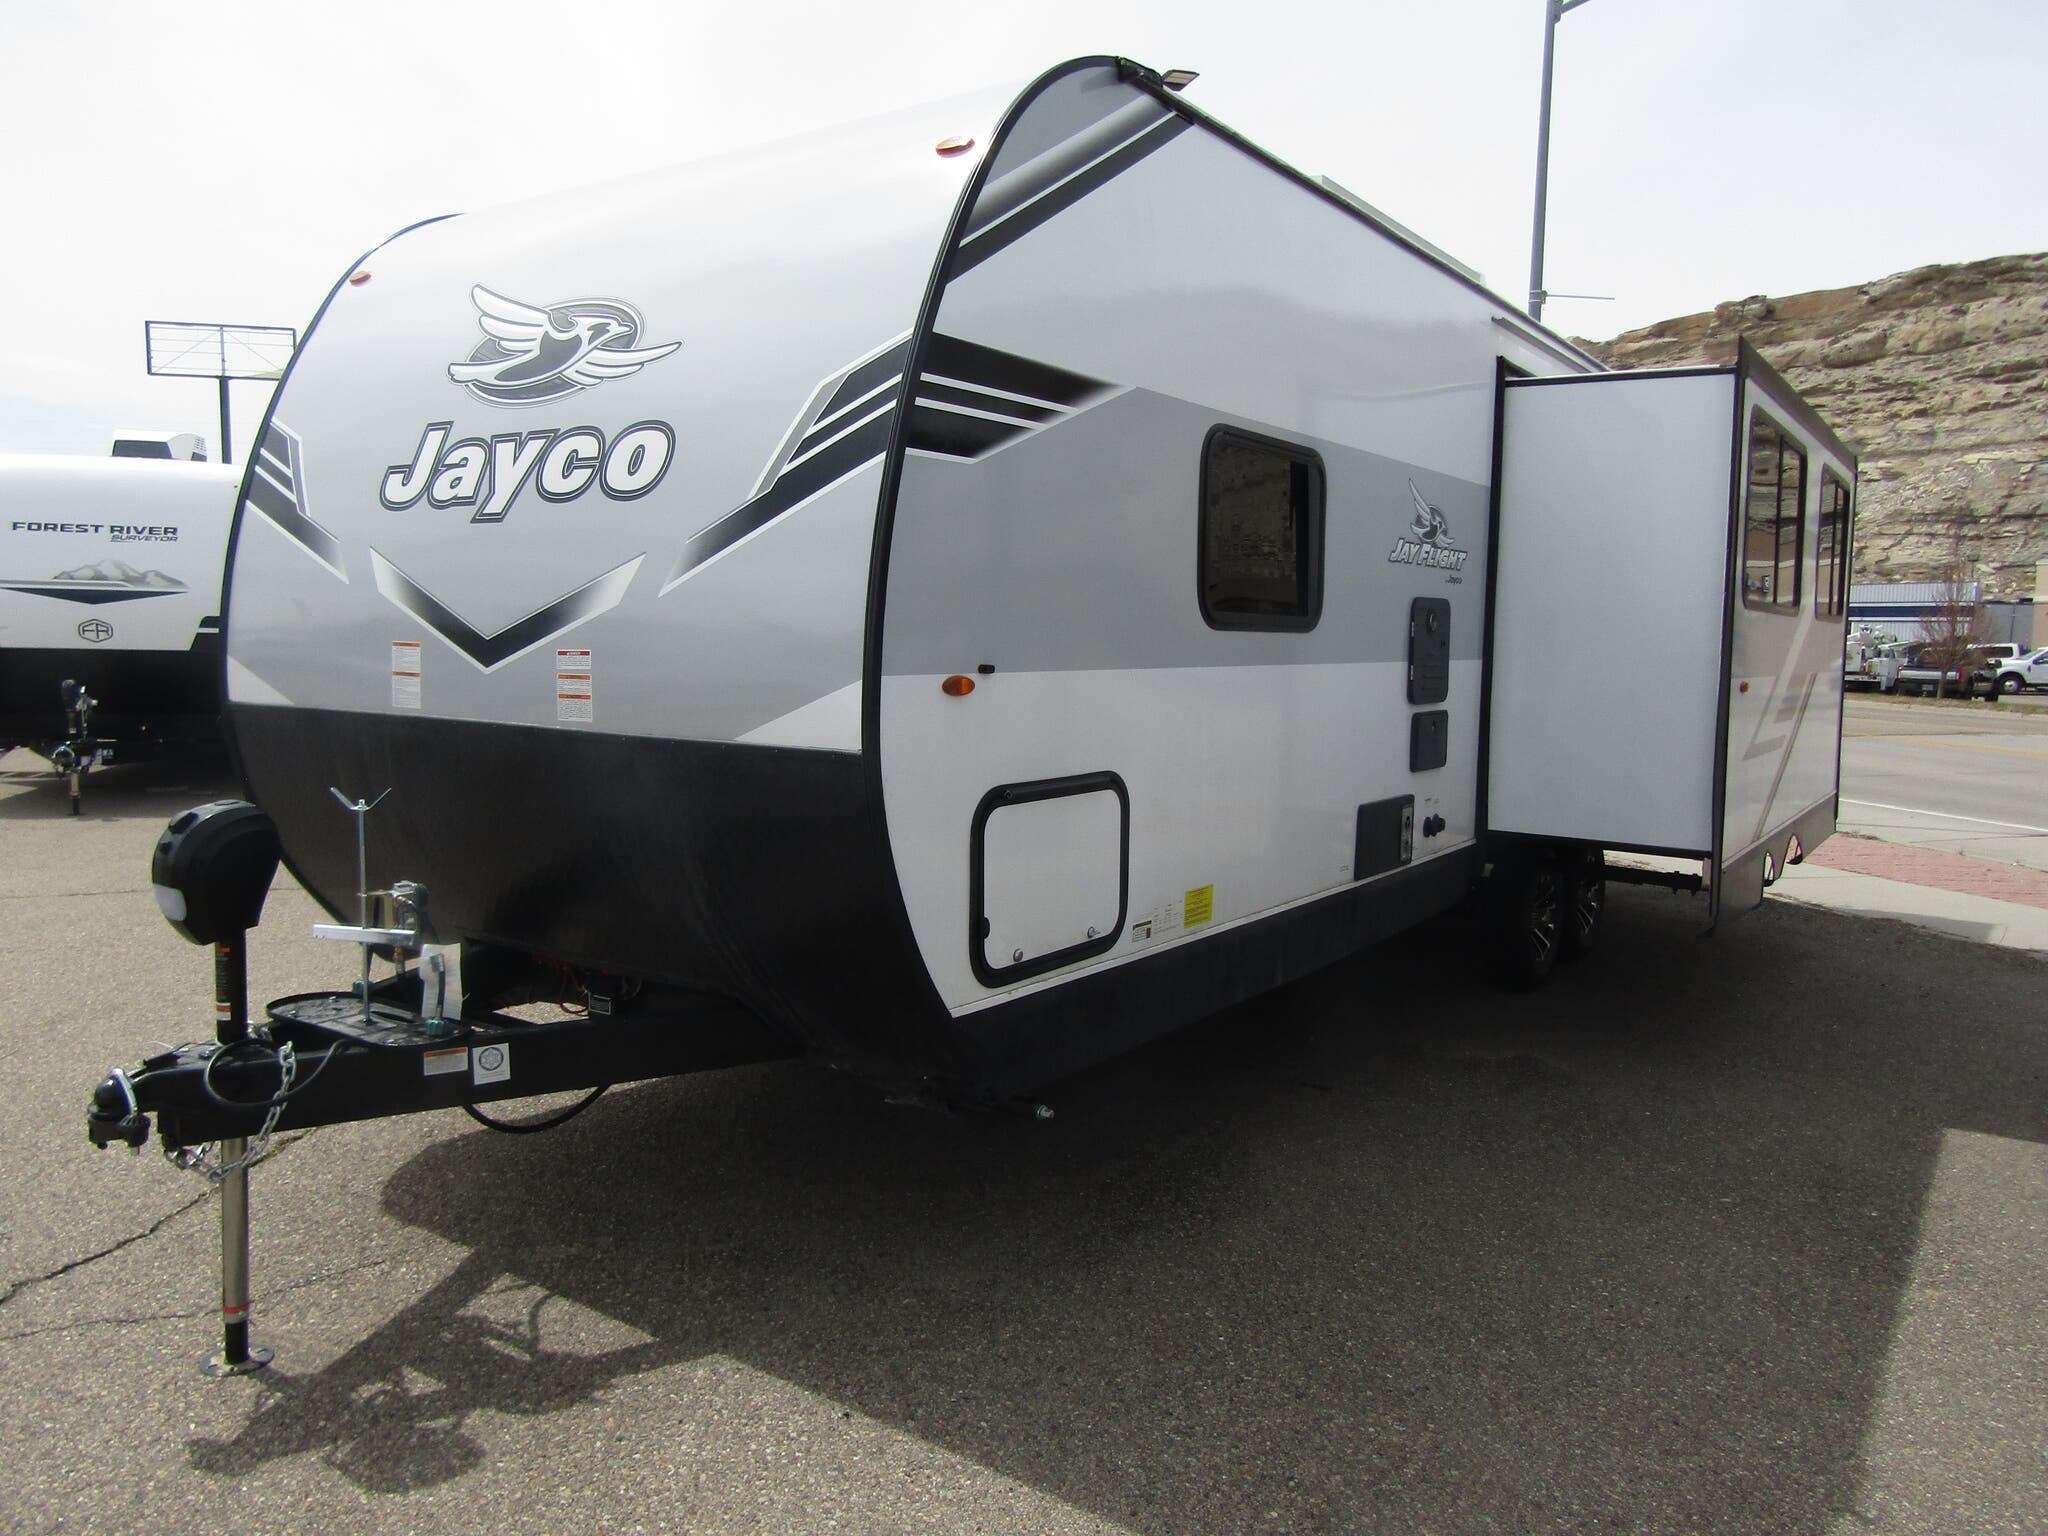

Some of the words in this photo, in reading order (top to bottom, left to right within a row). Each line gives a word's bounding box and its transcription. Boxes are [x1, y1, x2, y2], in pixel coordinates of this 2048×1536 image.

[380, 420, 677, 524] Jayco
[12, 522, 104, 534] FOREST
[110, 525, 178, 535] RIVER
[111, 534, 178, 542] SURVEYOR
[1388, 538, 1420, 564] JAY
[1416, 542, 1467, 571] FLIGHT
